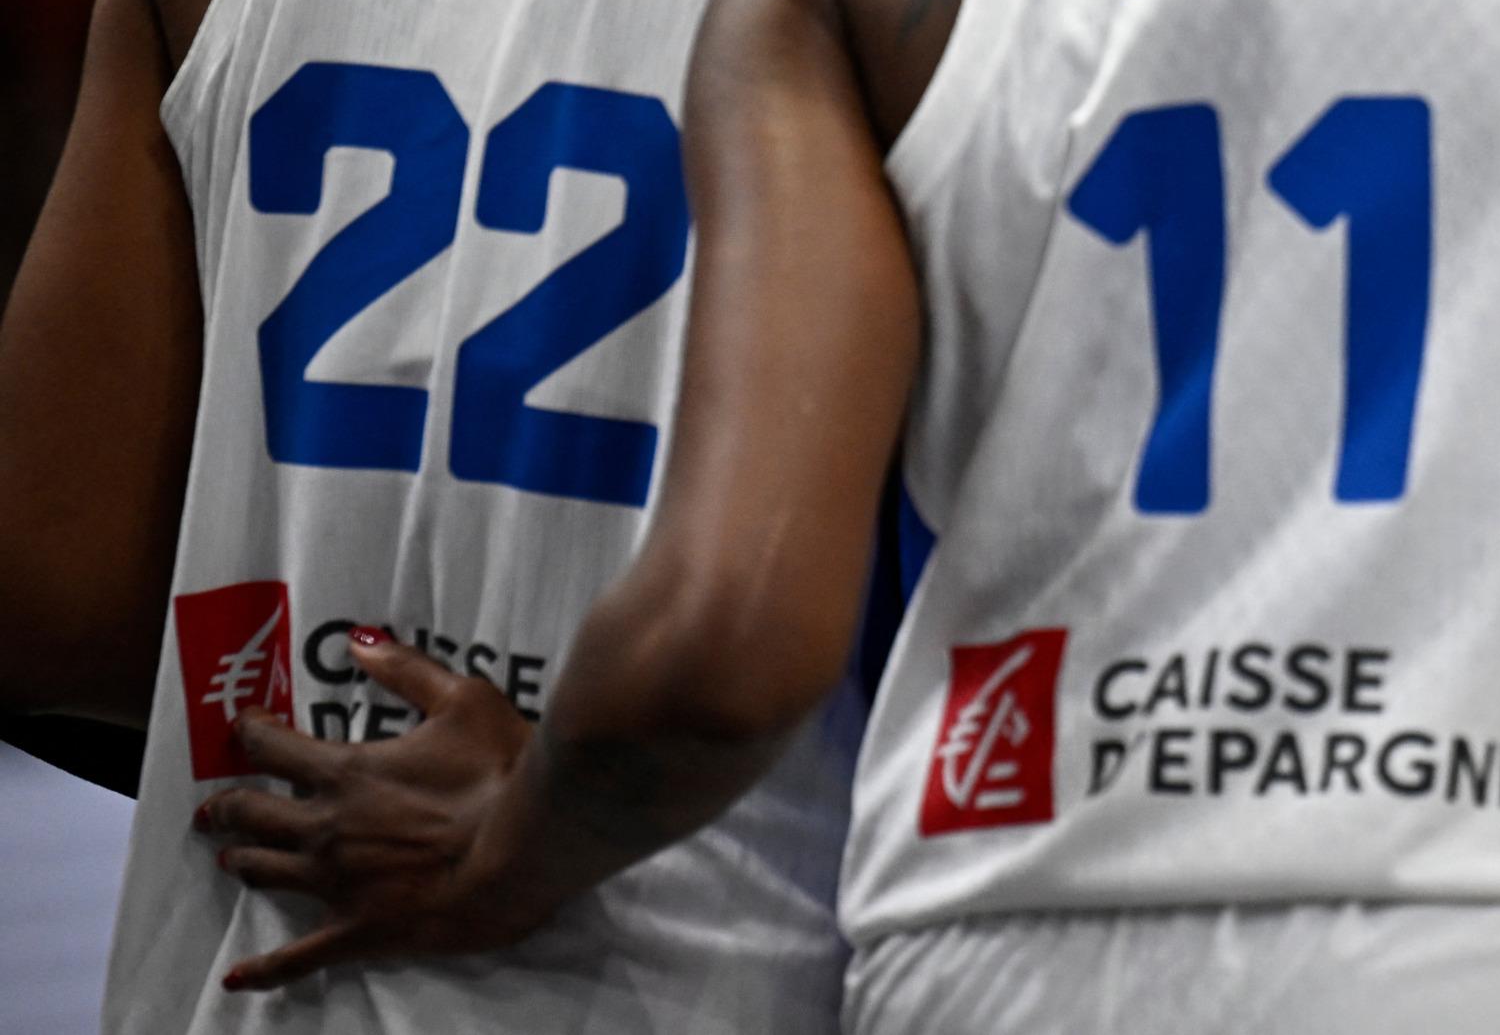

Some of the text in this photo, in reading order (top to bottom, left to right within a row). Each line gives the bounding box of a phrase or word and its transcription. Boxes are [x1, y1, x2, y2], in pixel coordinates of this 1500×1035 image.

[248, 61, 692, 510] 22
[1064, 93, 1434, 516] 11
[1092, 642, 1392, 722] CAISSE
